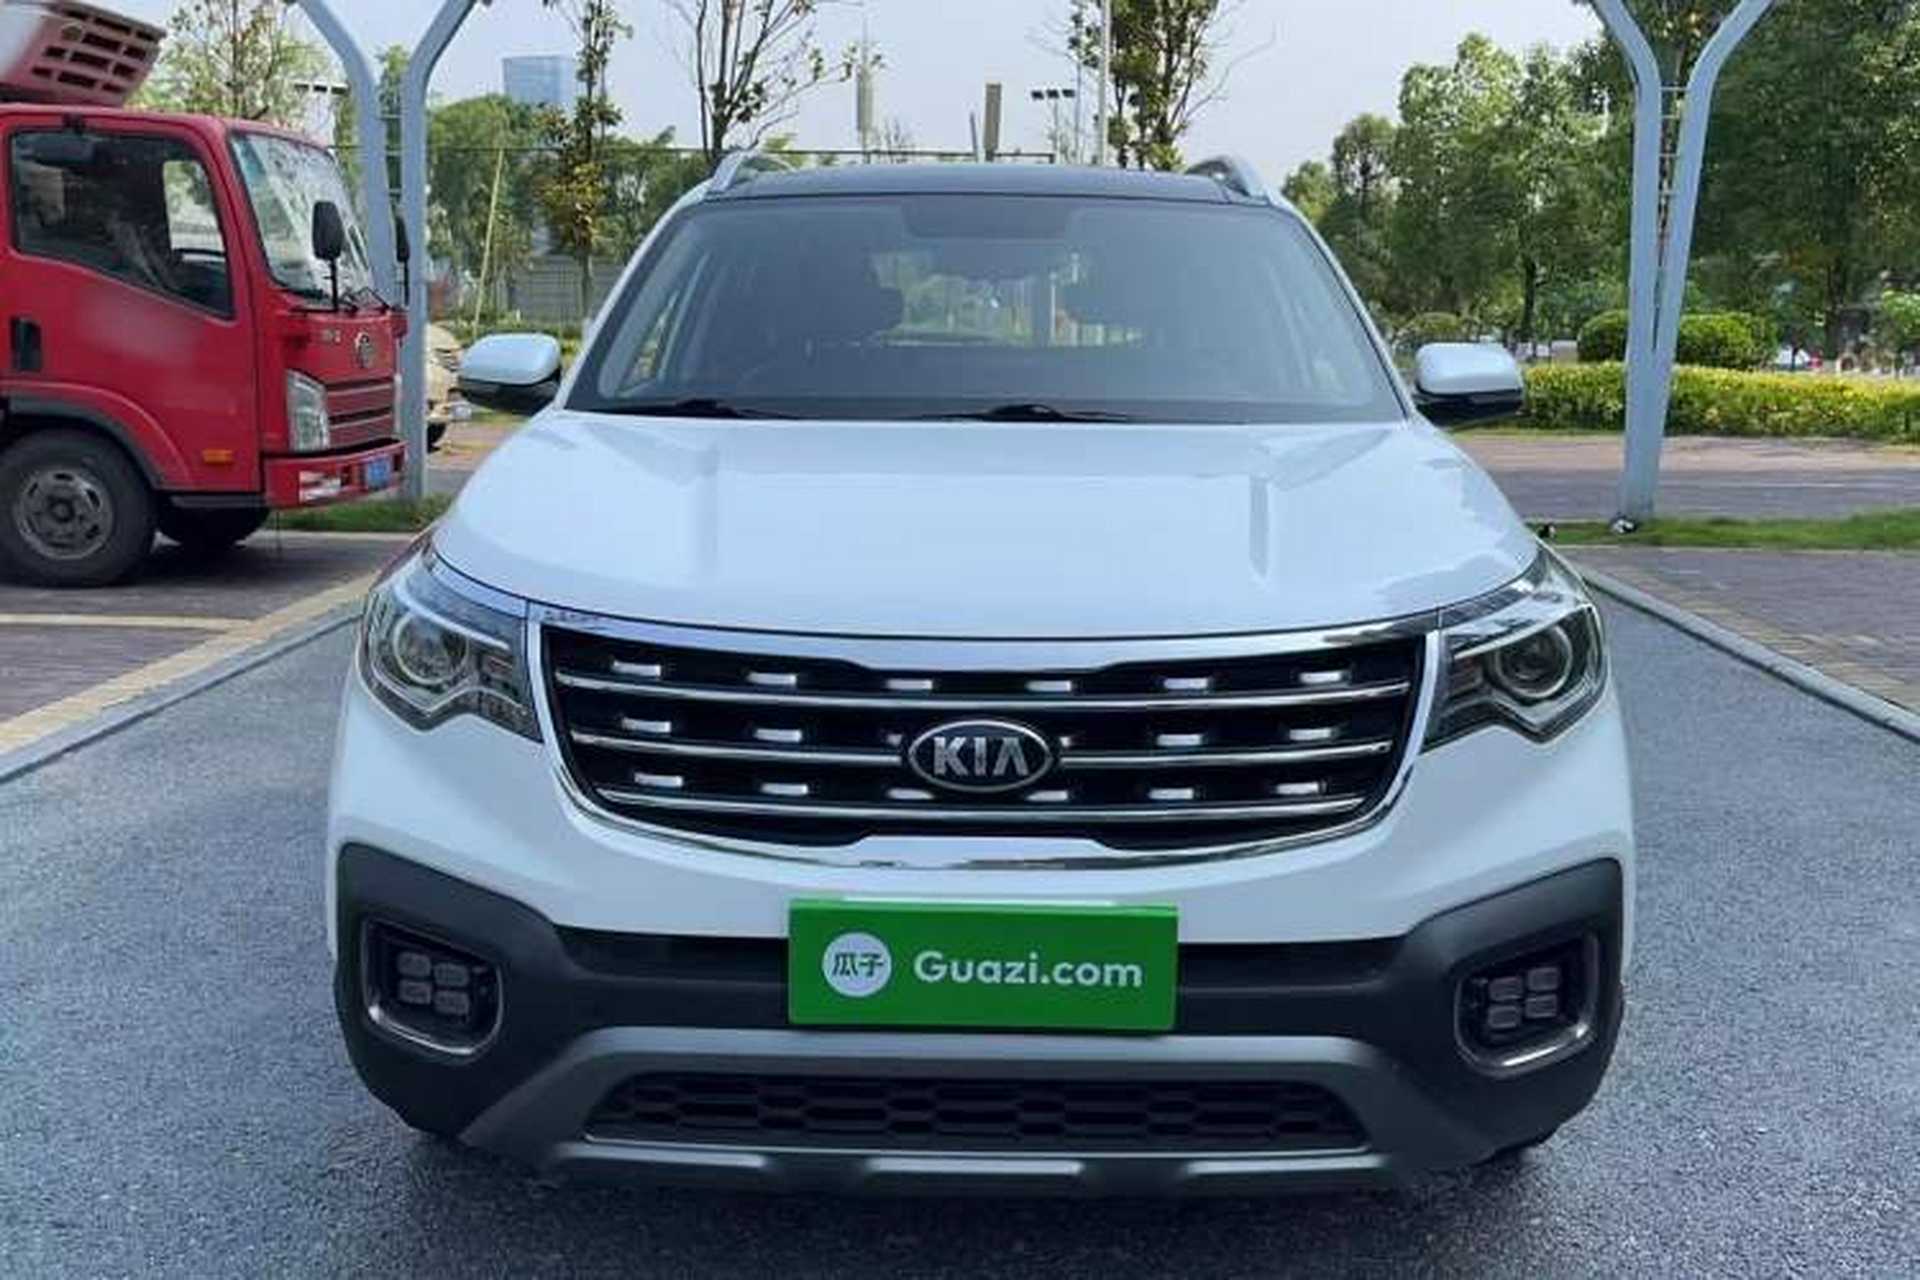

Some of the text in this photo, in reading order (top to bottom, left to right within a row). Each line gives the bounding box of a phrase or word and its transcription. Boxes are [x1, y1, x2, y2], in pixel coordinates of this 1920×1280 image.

[932, 735, 1029, 777] KIA
[832, 951, 885, 978] 瓜子
[913, 949, 1143, 988] Guazi.com
